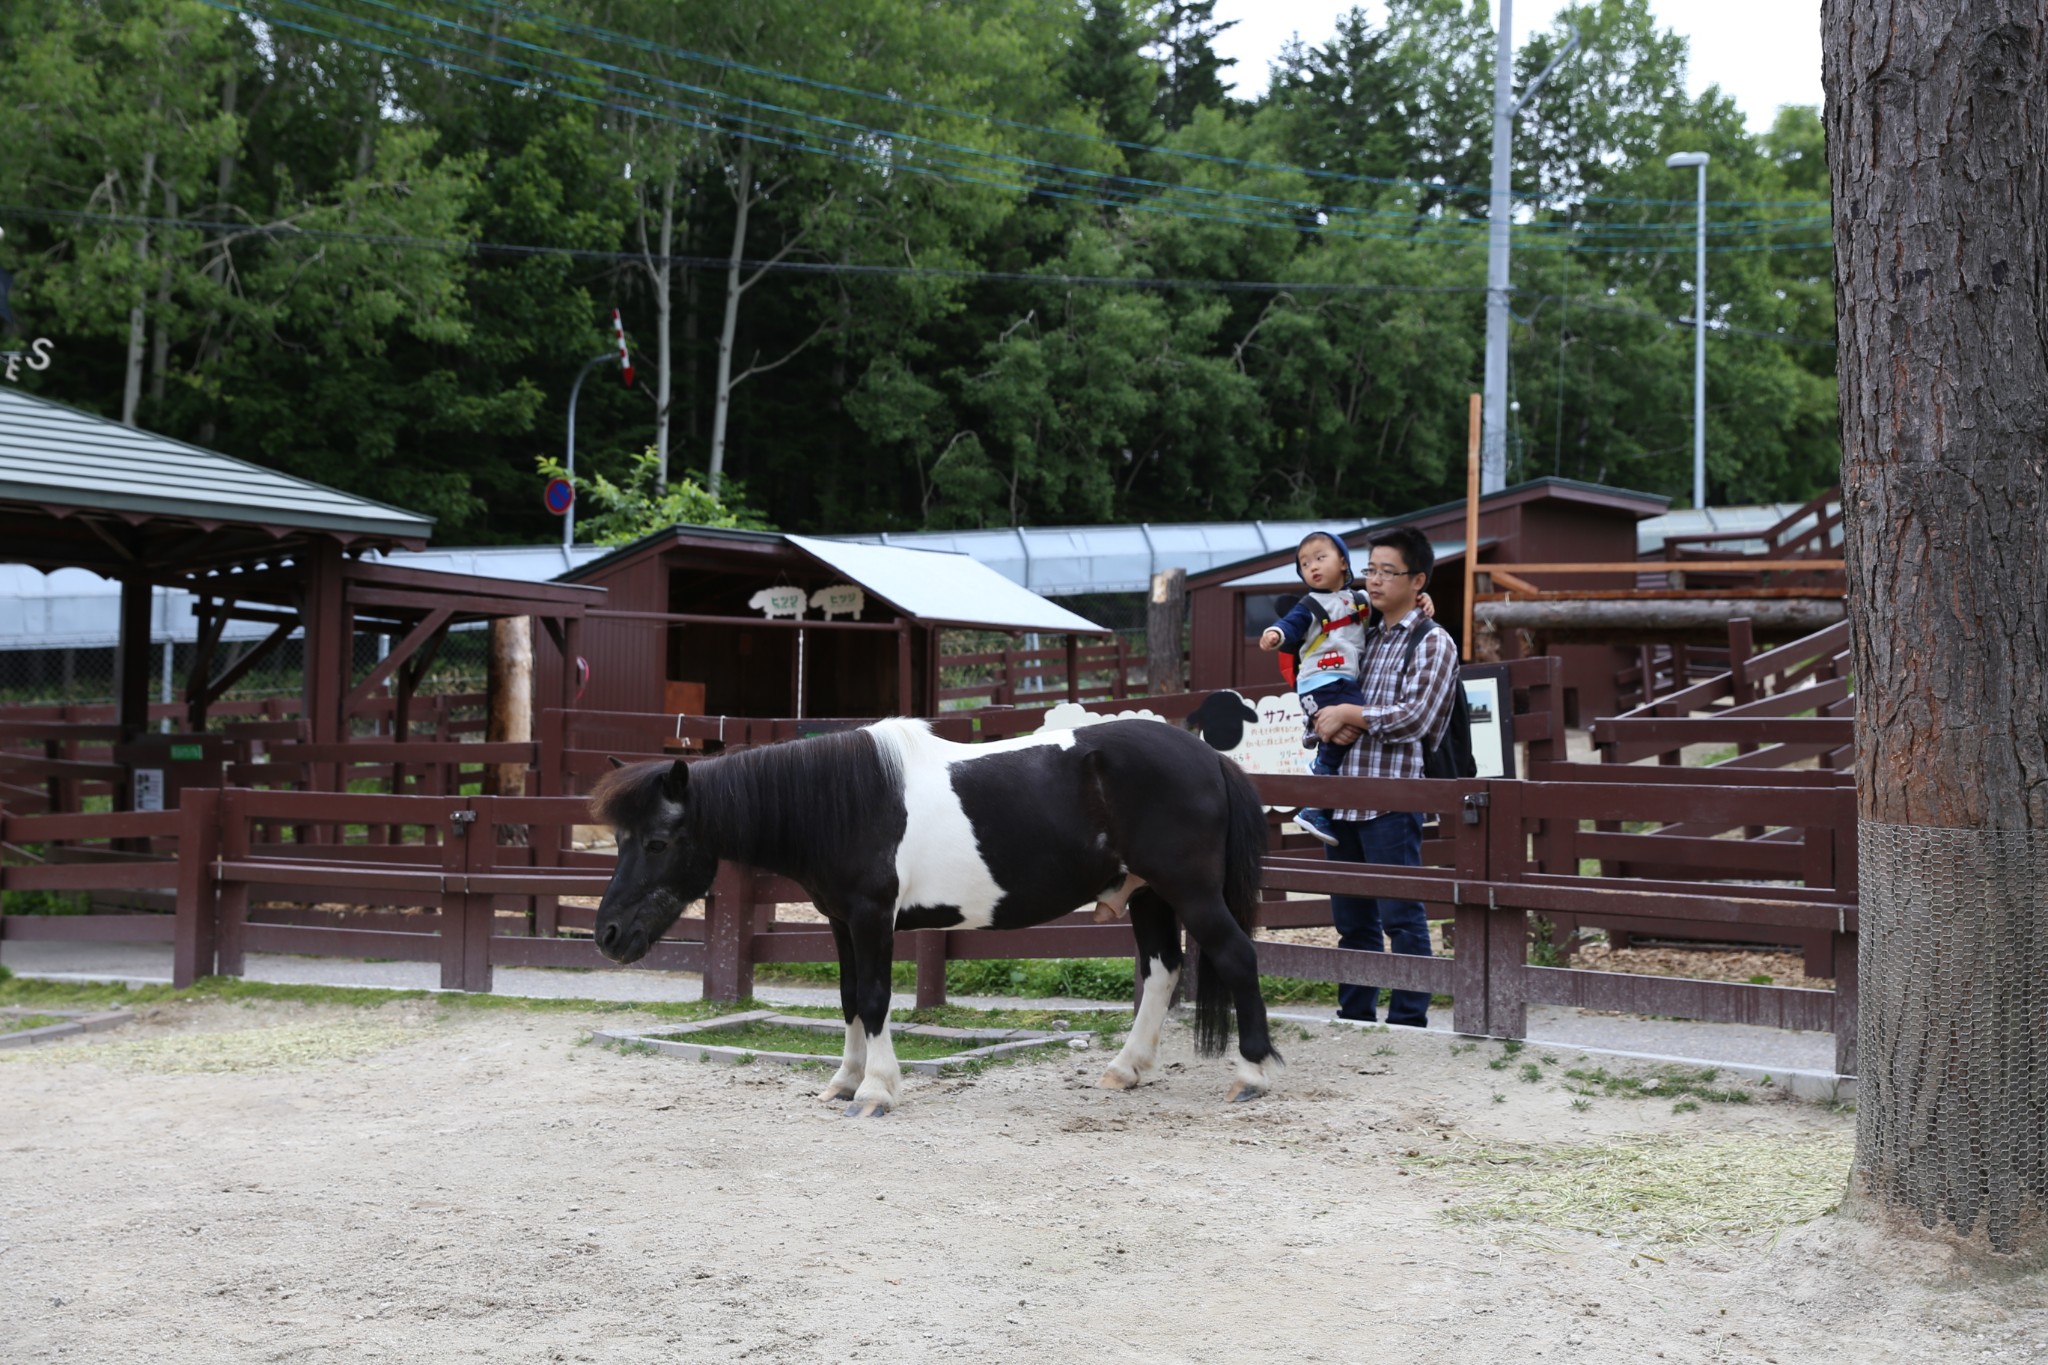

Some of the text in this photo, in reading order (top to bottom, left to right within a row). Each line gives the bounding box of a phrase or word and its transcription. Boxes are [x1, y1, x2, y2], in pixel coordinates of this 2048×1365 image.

[25, 337, 54, 370] S
[5, 354, 21, 382] E
[1264, 710, 1303, 724] サフォー
